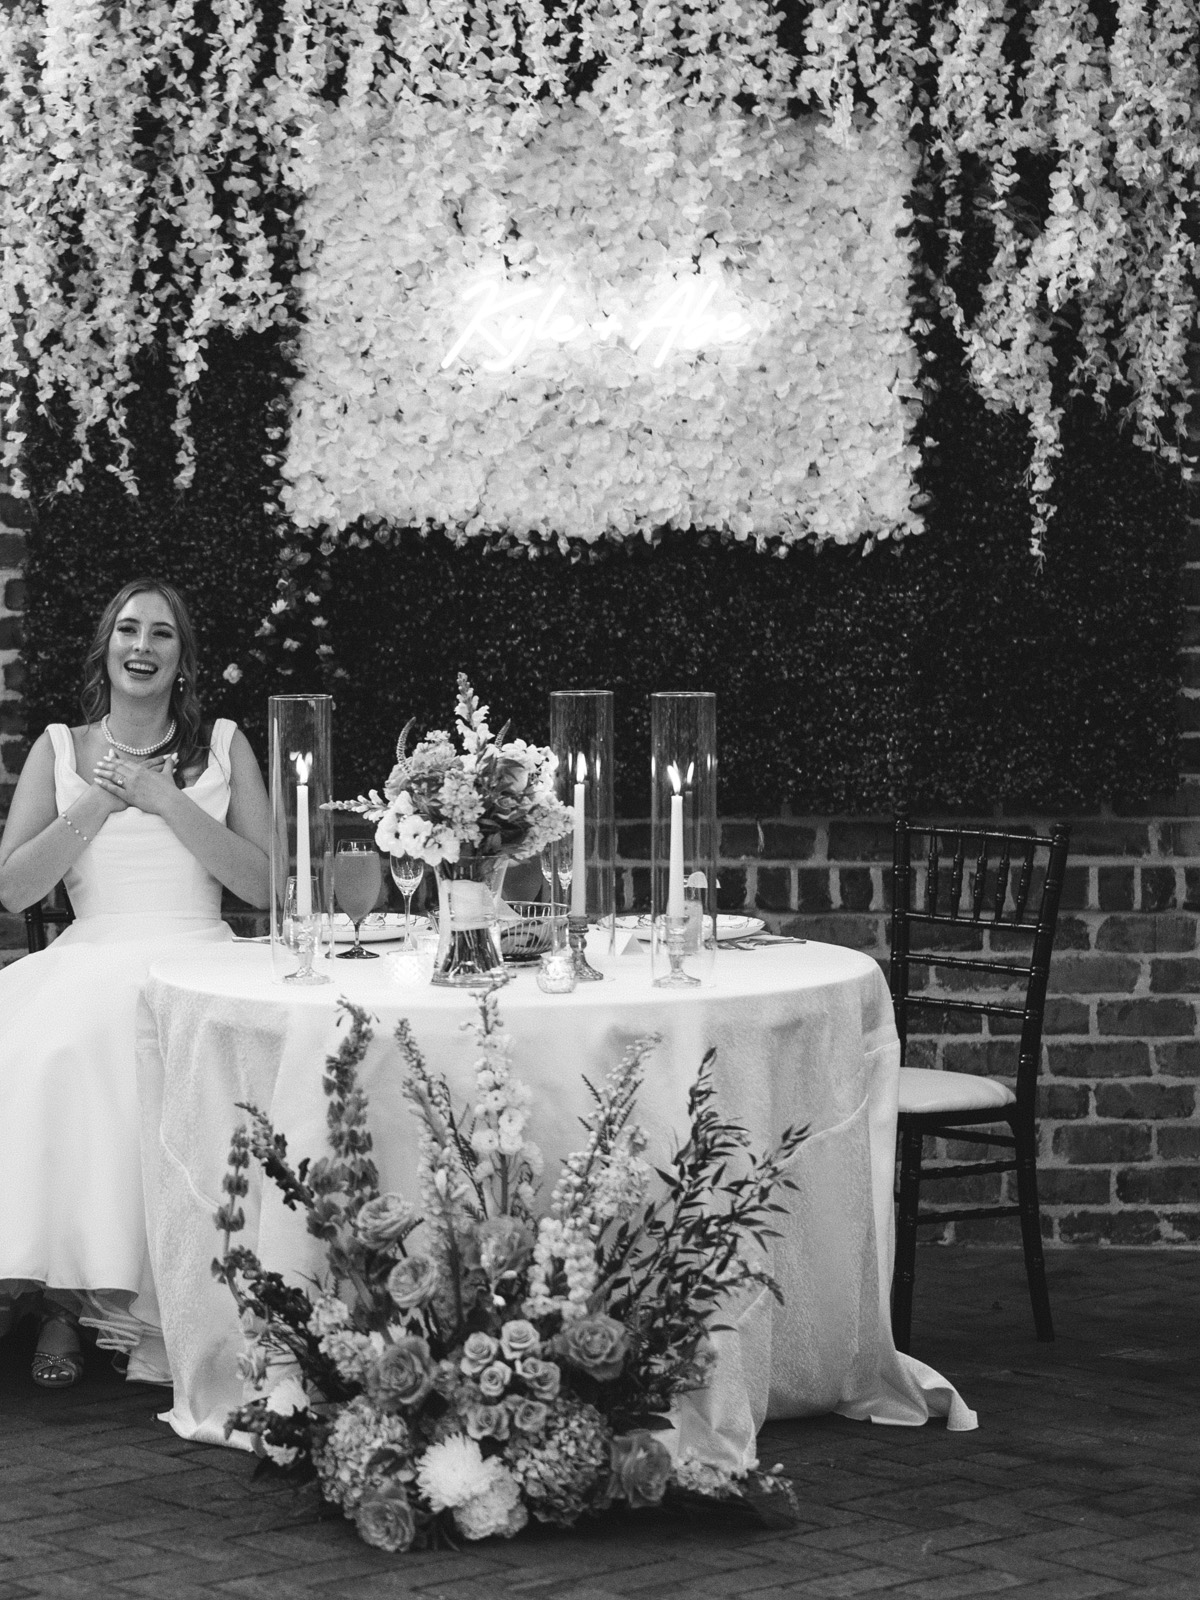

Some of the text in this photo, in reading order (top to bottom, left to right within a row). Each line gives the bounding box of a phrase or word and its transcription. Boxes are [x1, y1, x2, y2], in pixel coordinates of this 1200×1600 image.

[440, 280, 751, 371] Kyle + Abe
